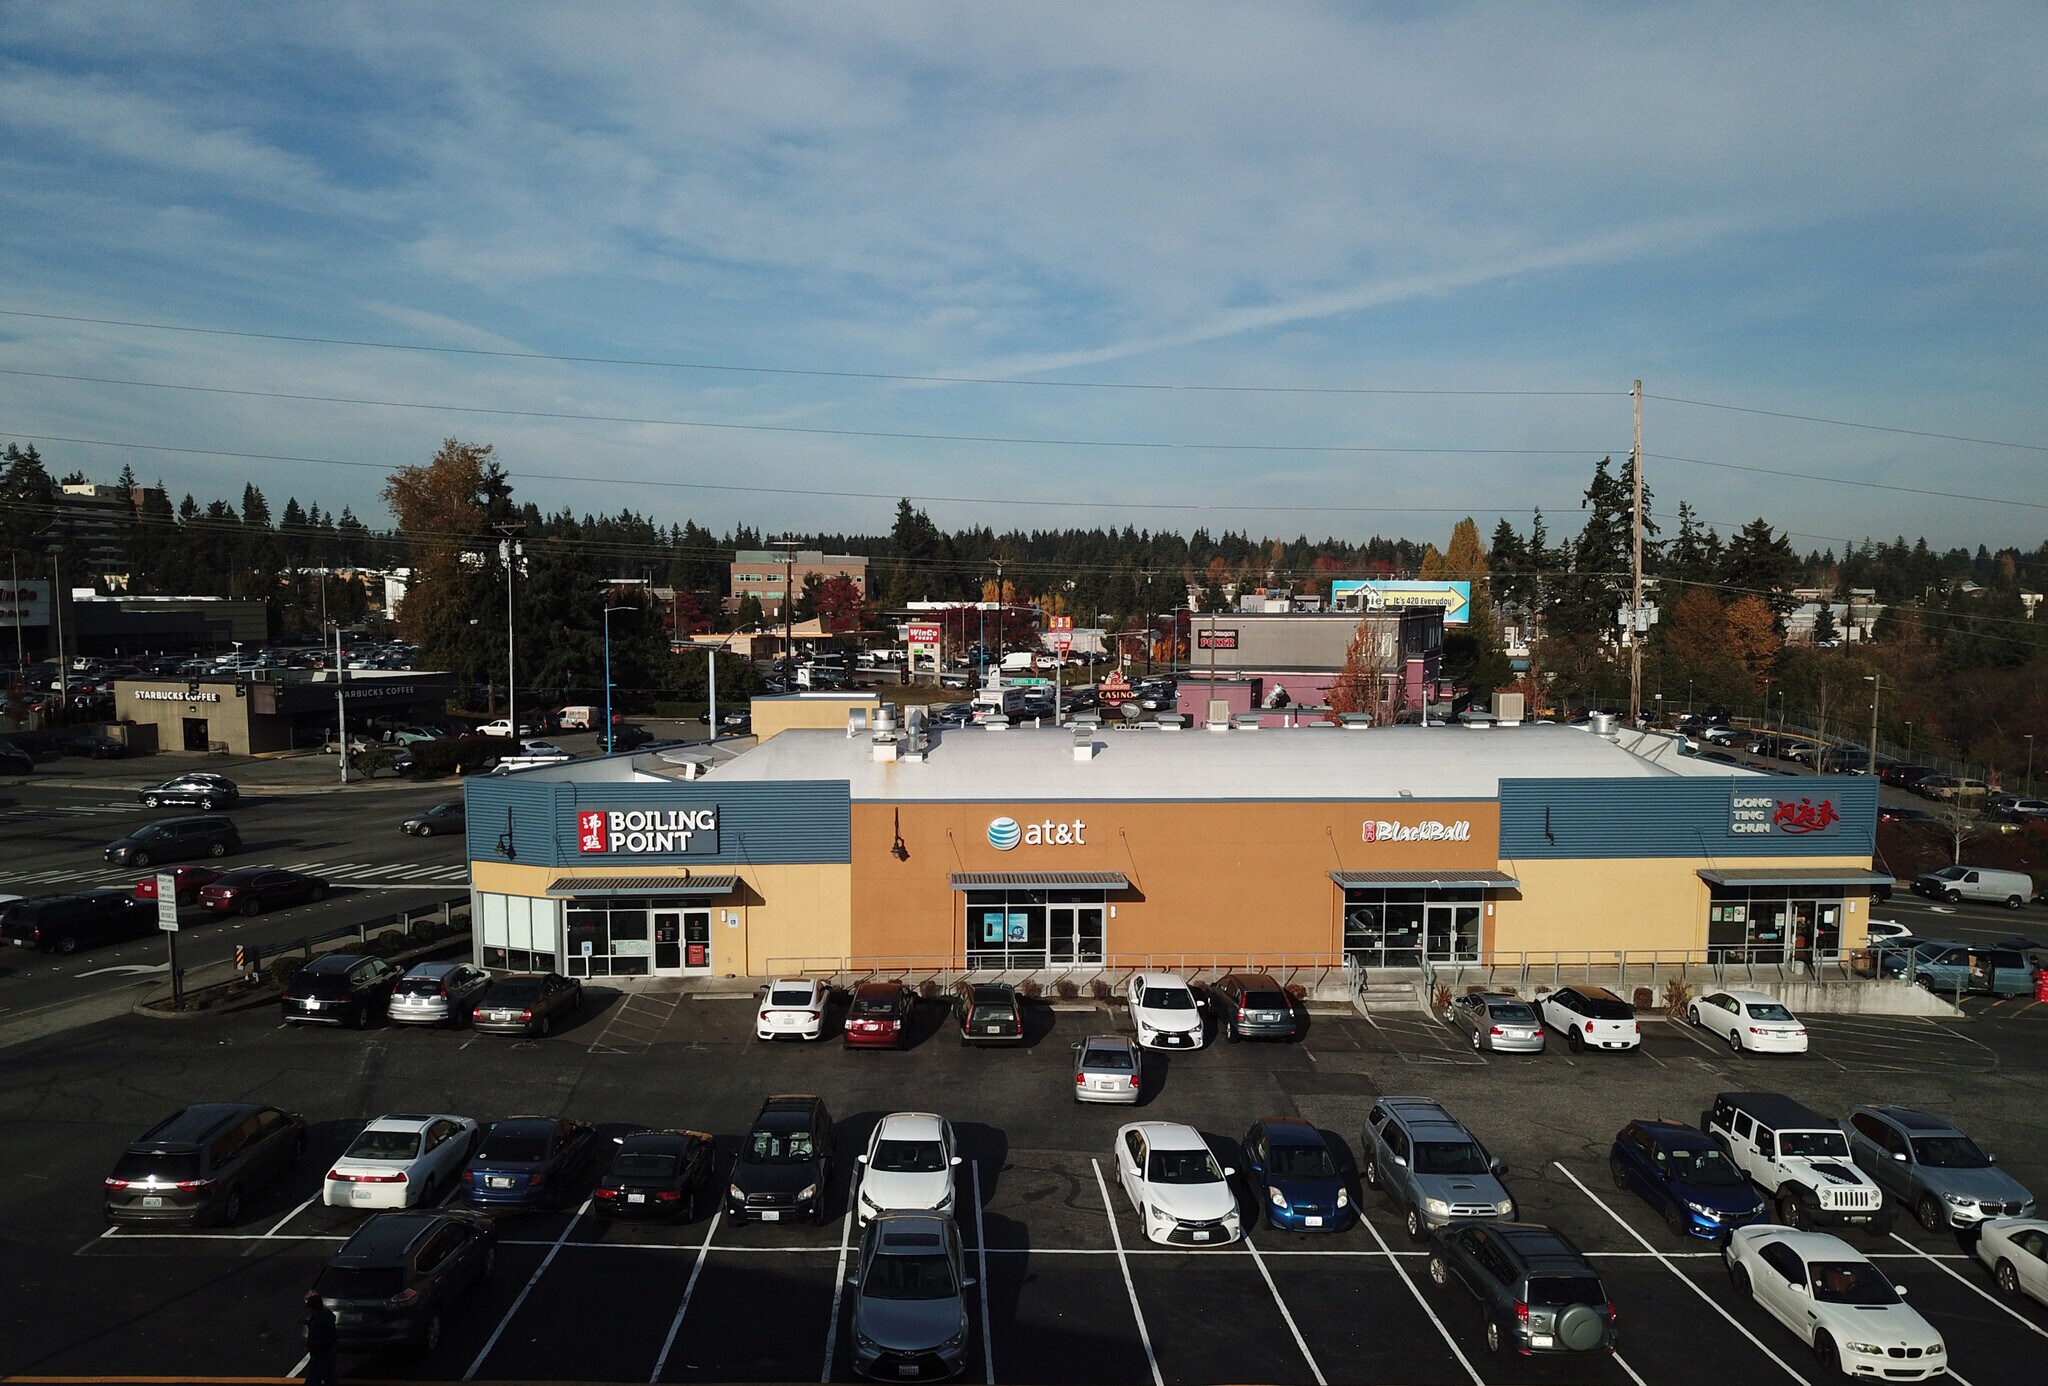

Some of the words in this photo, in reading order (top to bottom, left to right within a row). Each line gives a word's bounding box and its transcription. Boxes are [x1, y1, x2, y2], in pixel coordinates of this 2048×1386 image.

[1420, 597, 1455, 606] Everyday!
[134, 690, 184, 700] STARBUCKS
[334, 688, 384, 699] SARBUCKS
[386, 686, 415, 695] COFFEE
[1099, 691, 1134, 699] CASINO
[1733, 798, 1772, 807] DONG
[1732, 811, 1765, 820] TING
[609, 811, 716, 831] BOILING
[1025, 819, 1086, 844] at&t
[1376, 820, 1471, 841] BlackBall
[1731, 823, 1770, 833] CHUN
[609, 831, 692, 852] POINT
